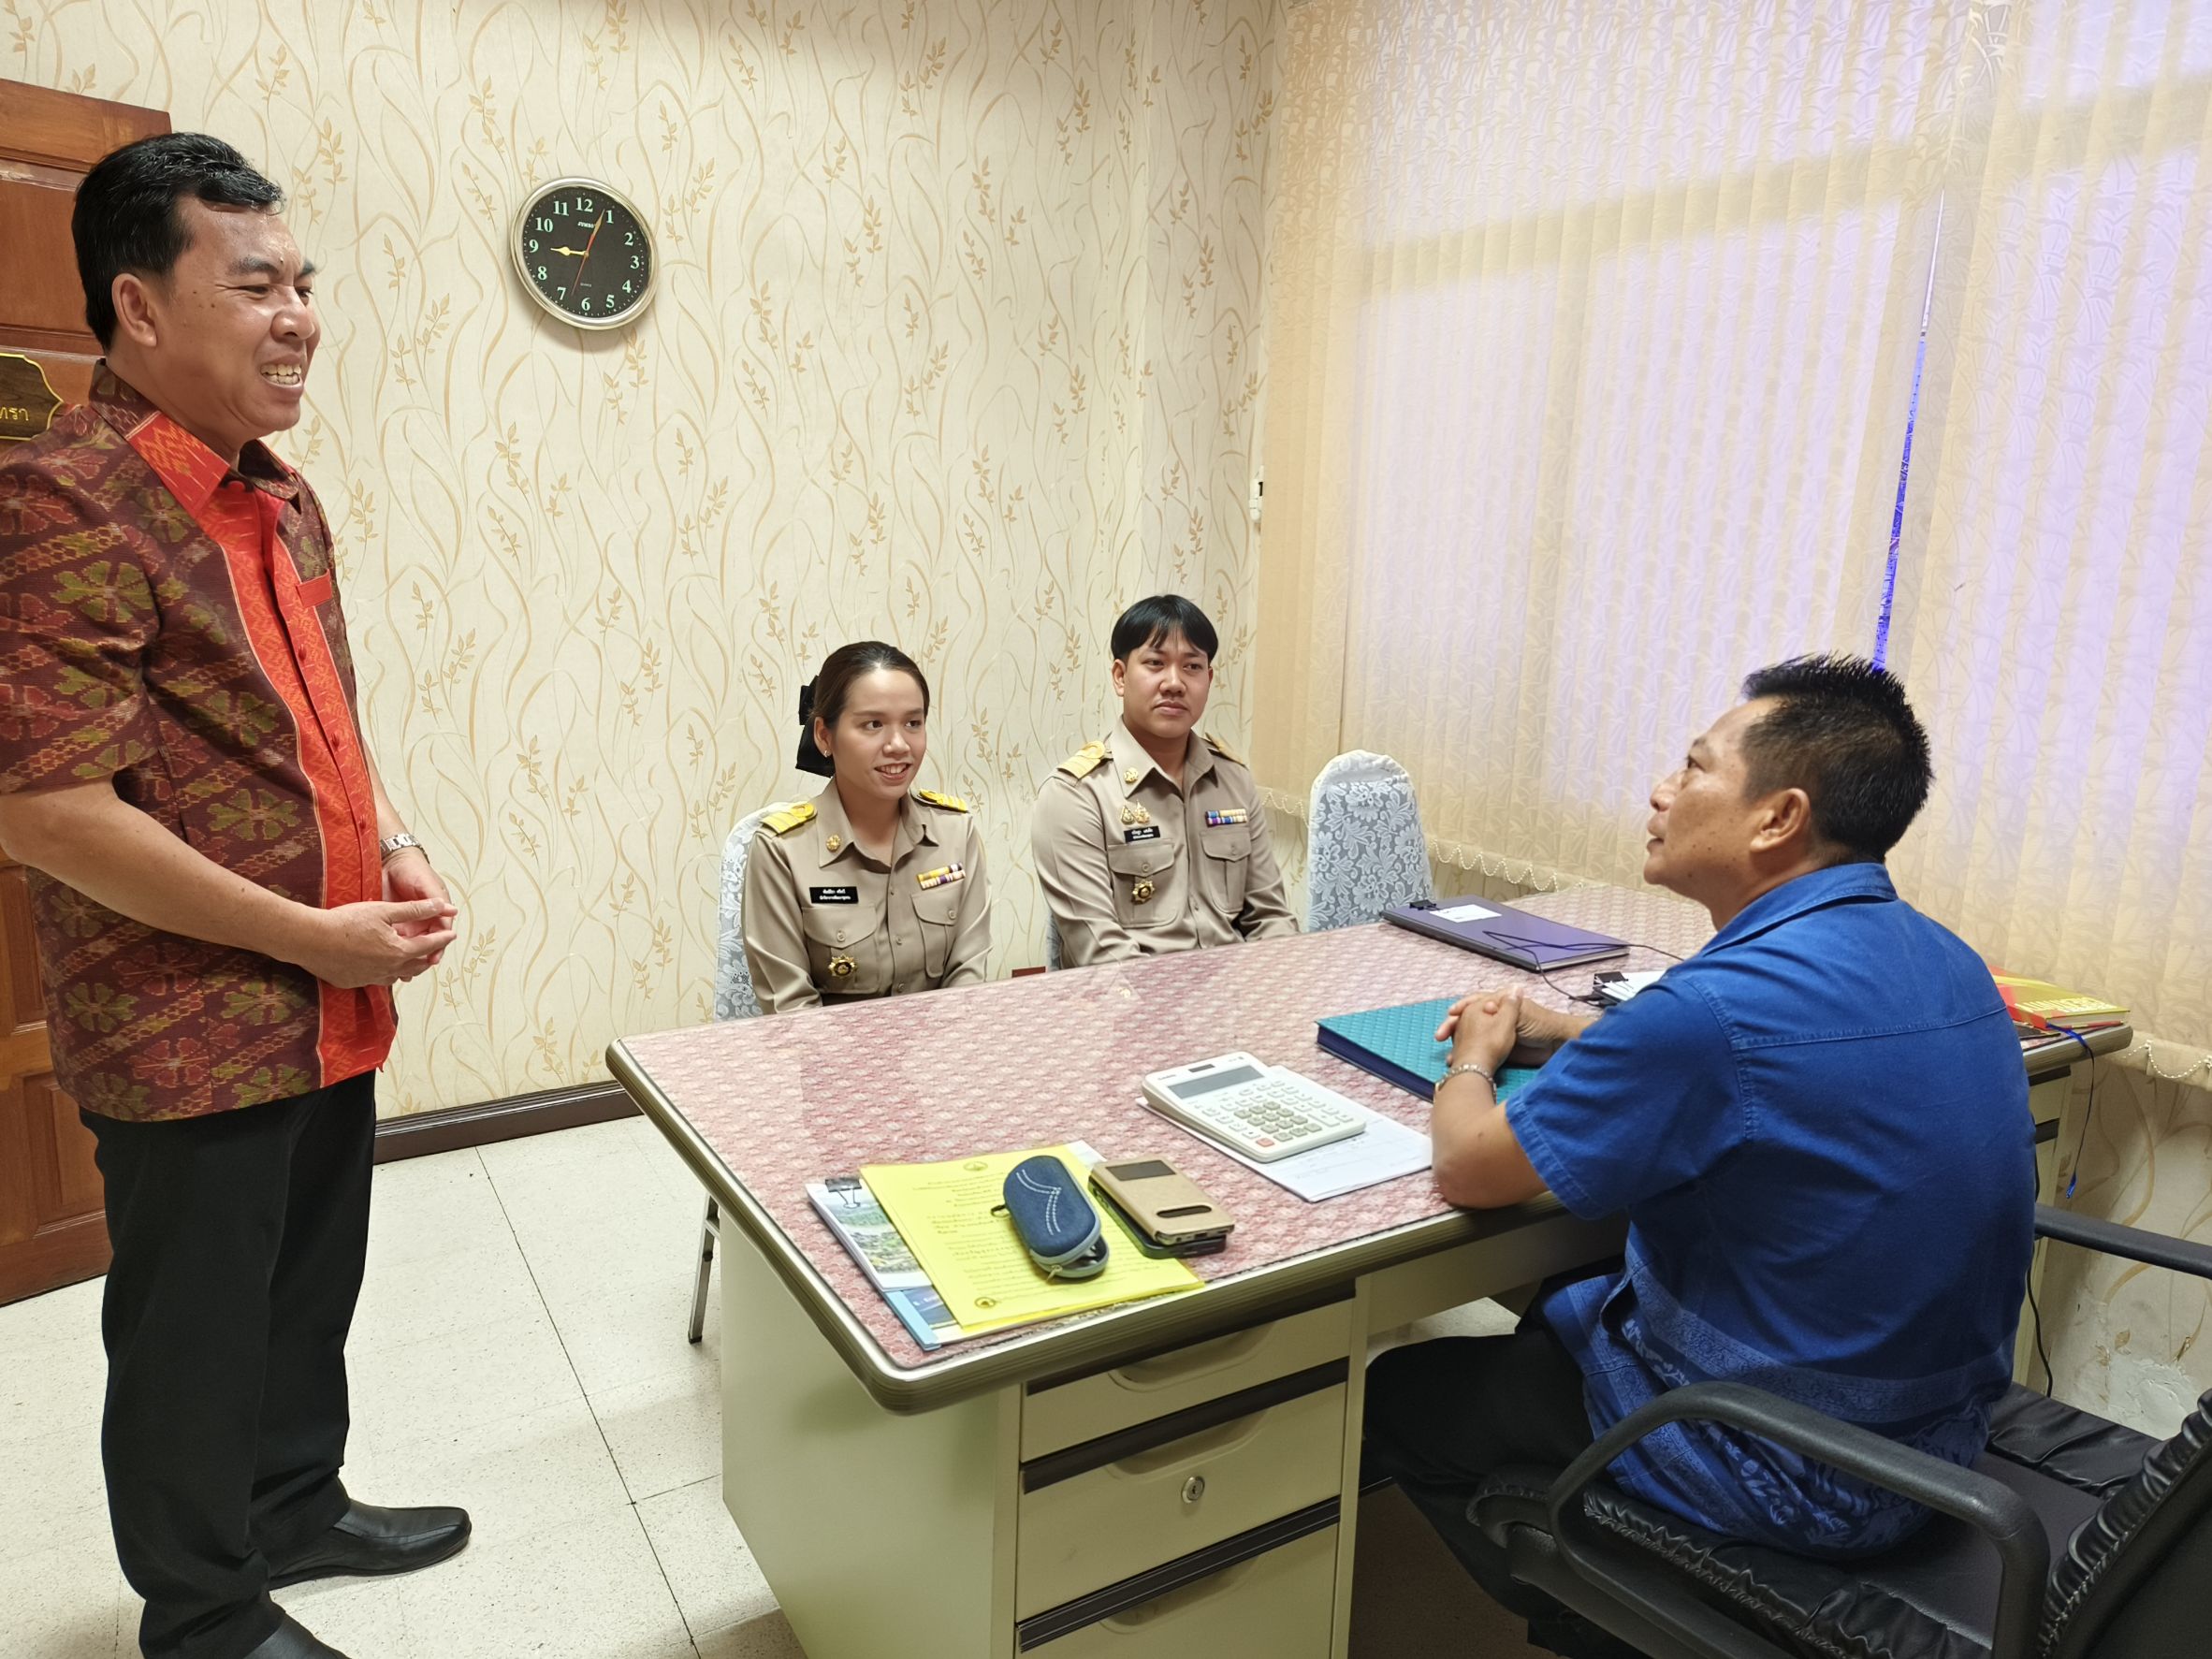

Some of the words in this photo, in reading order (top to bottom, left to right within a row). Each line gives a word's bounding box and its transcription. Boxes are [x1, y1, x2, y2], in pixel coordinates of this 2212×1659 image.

[553, 201, 569, 216] 11
[575, 197, 593, 212] 12
[605, 210, 614, 224] 1
[535, 217, 553, 232] 10
[529, 240, 538, 253] 9
[624, 233, 633, 246] 2
[630, 255, 639, 269] 3
[537, 266, 547, 280] 8
[557, 286, 566, 300] 7
[622, 280, 632, 293] 4
[581, 298, 590, 311] 6
[605, 295, 614, 308] 5
